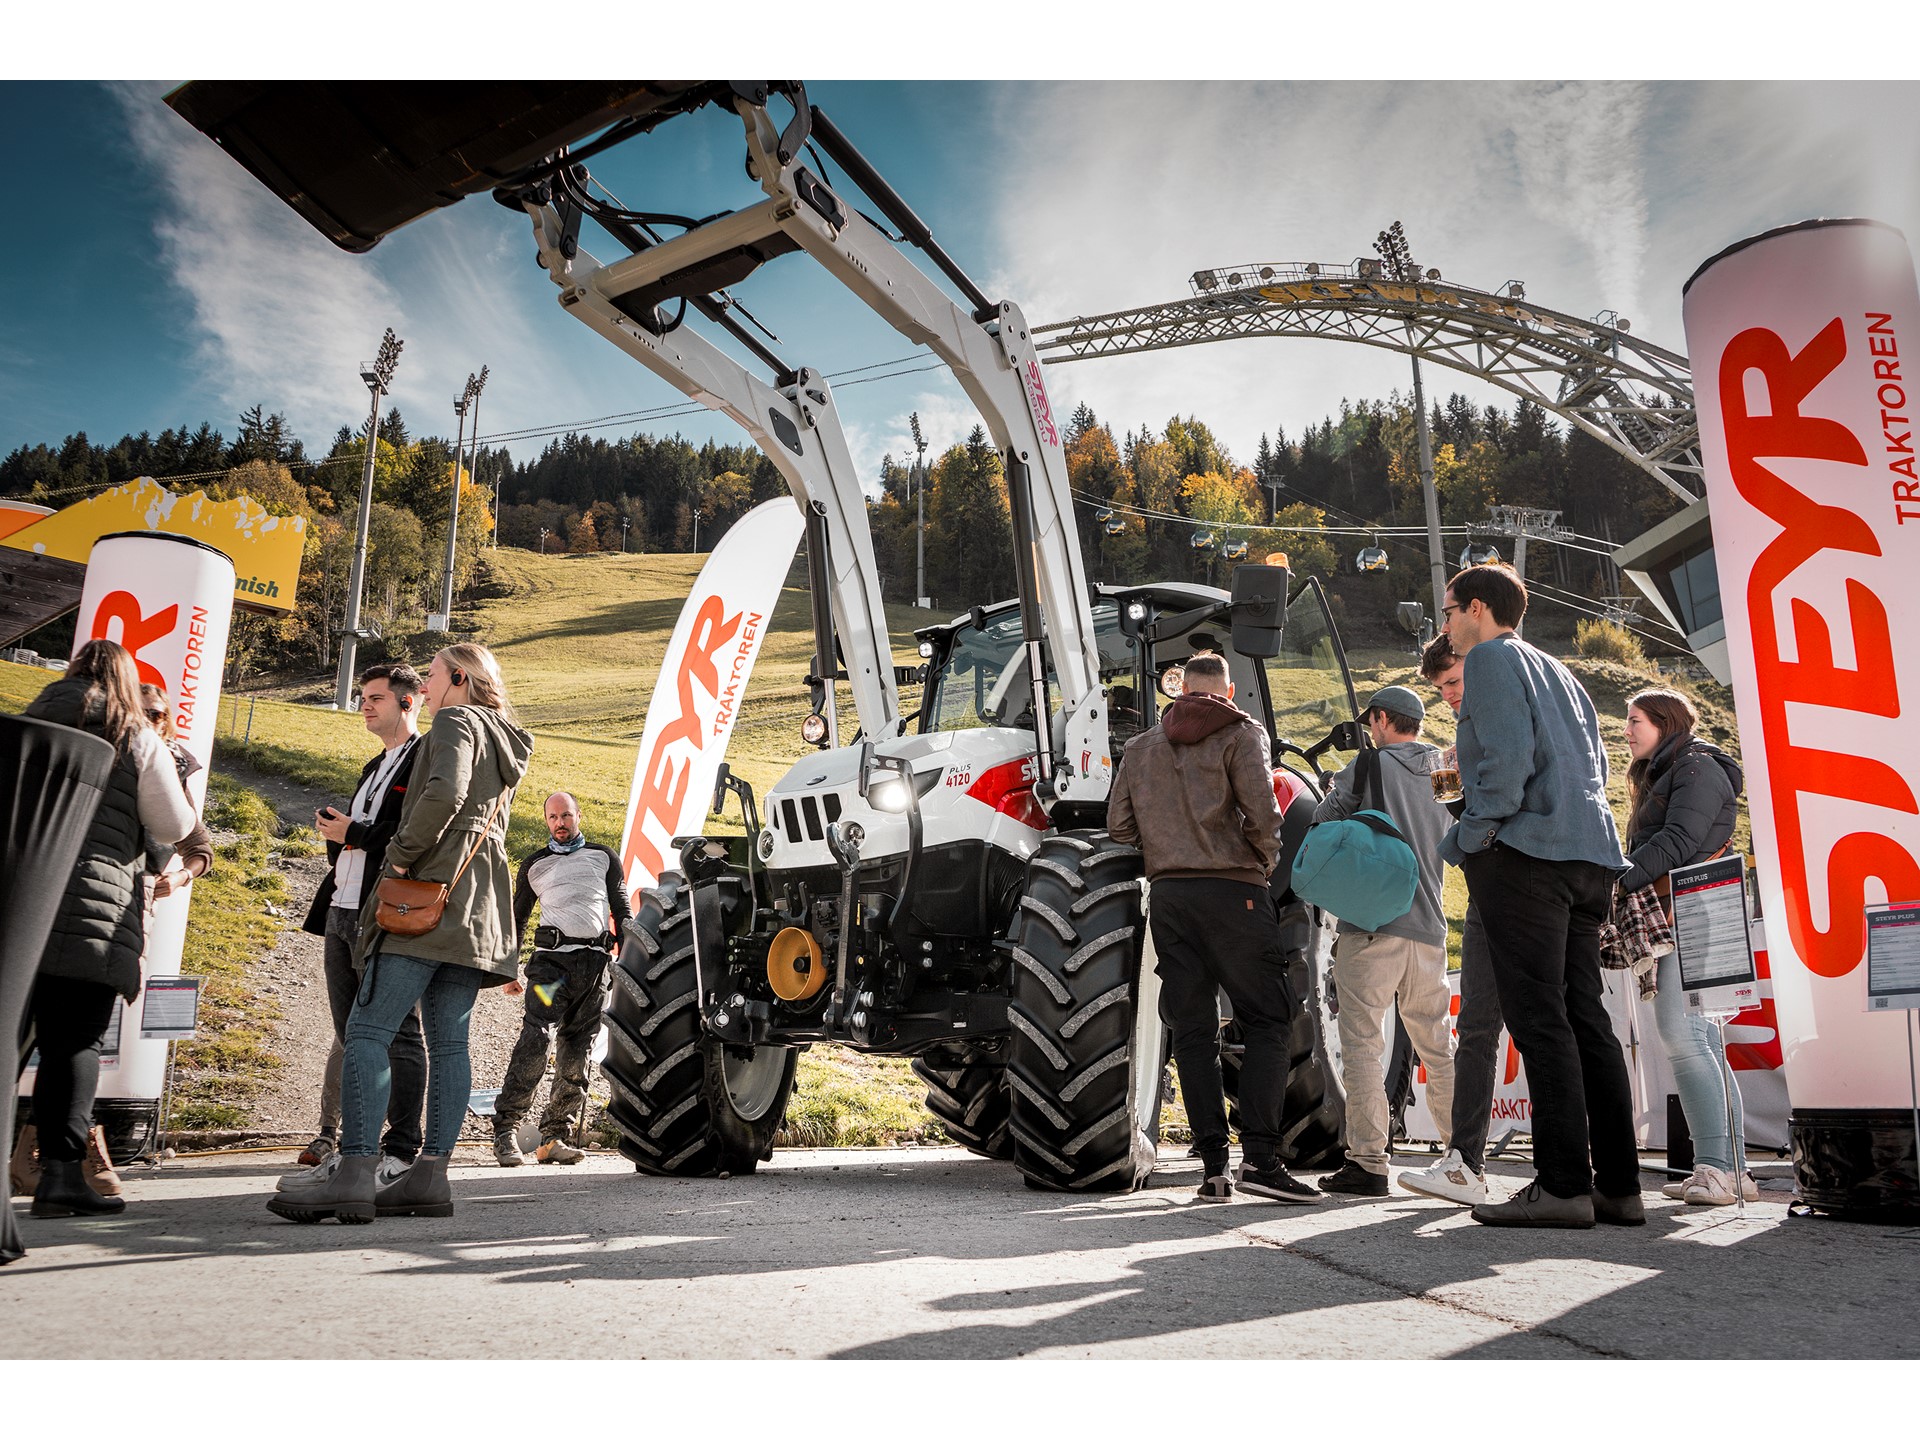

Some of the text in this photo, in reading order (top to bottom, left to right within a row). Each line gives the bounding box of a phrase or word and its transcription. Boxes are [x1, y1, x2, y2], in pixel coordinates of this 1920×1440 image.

[1026, 360, 1058, 447] STEYR
[1865, 311, 1920, 525] TRAKTOREN
[235, 575, 279, 598] nish
[174, 605, 208, 740] TRAKTOREN
[713, 612, 763, 737] TRAKTOREN
[1719, 316, 1920, 978] STEYR
[622, 595, 743, 918] TEYR
[946, 772, 970, 787] 4120
[949, 763, 971, 774] PLUS
[1676, 876, 1694, 886] STEYR
[1694, 873, 1708, 882] PLUS
